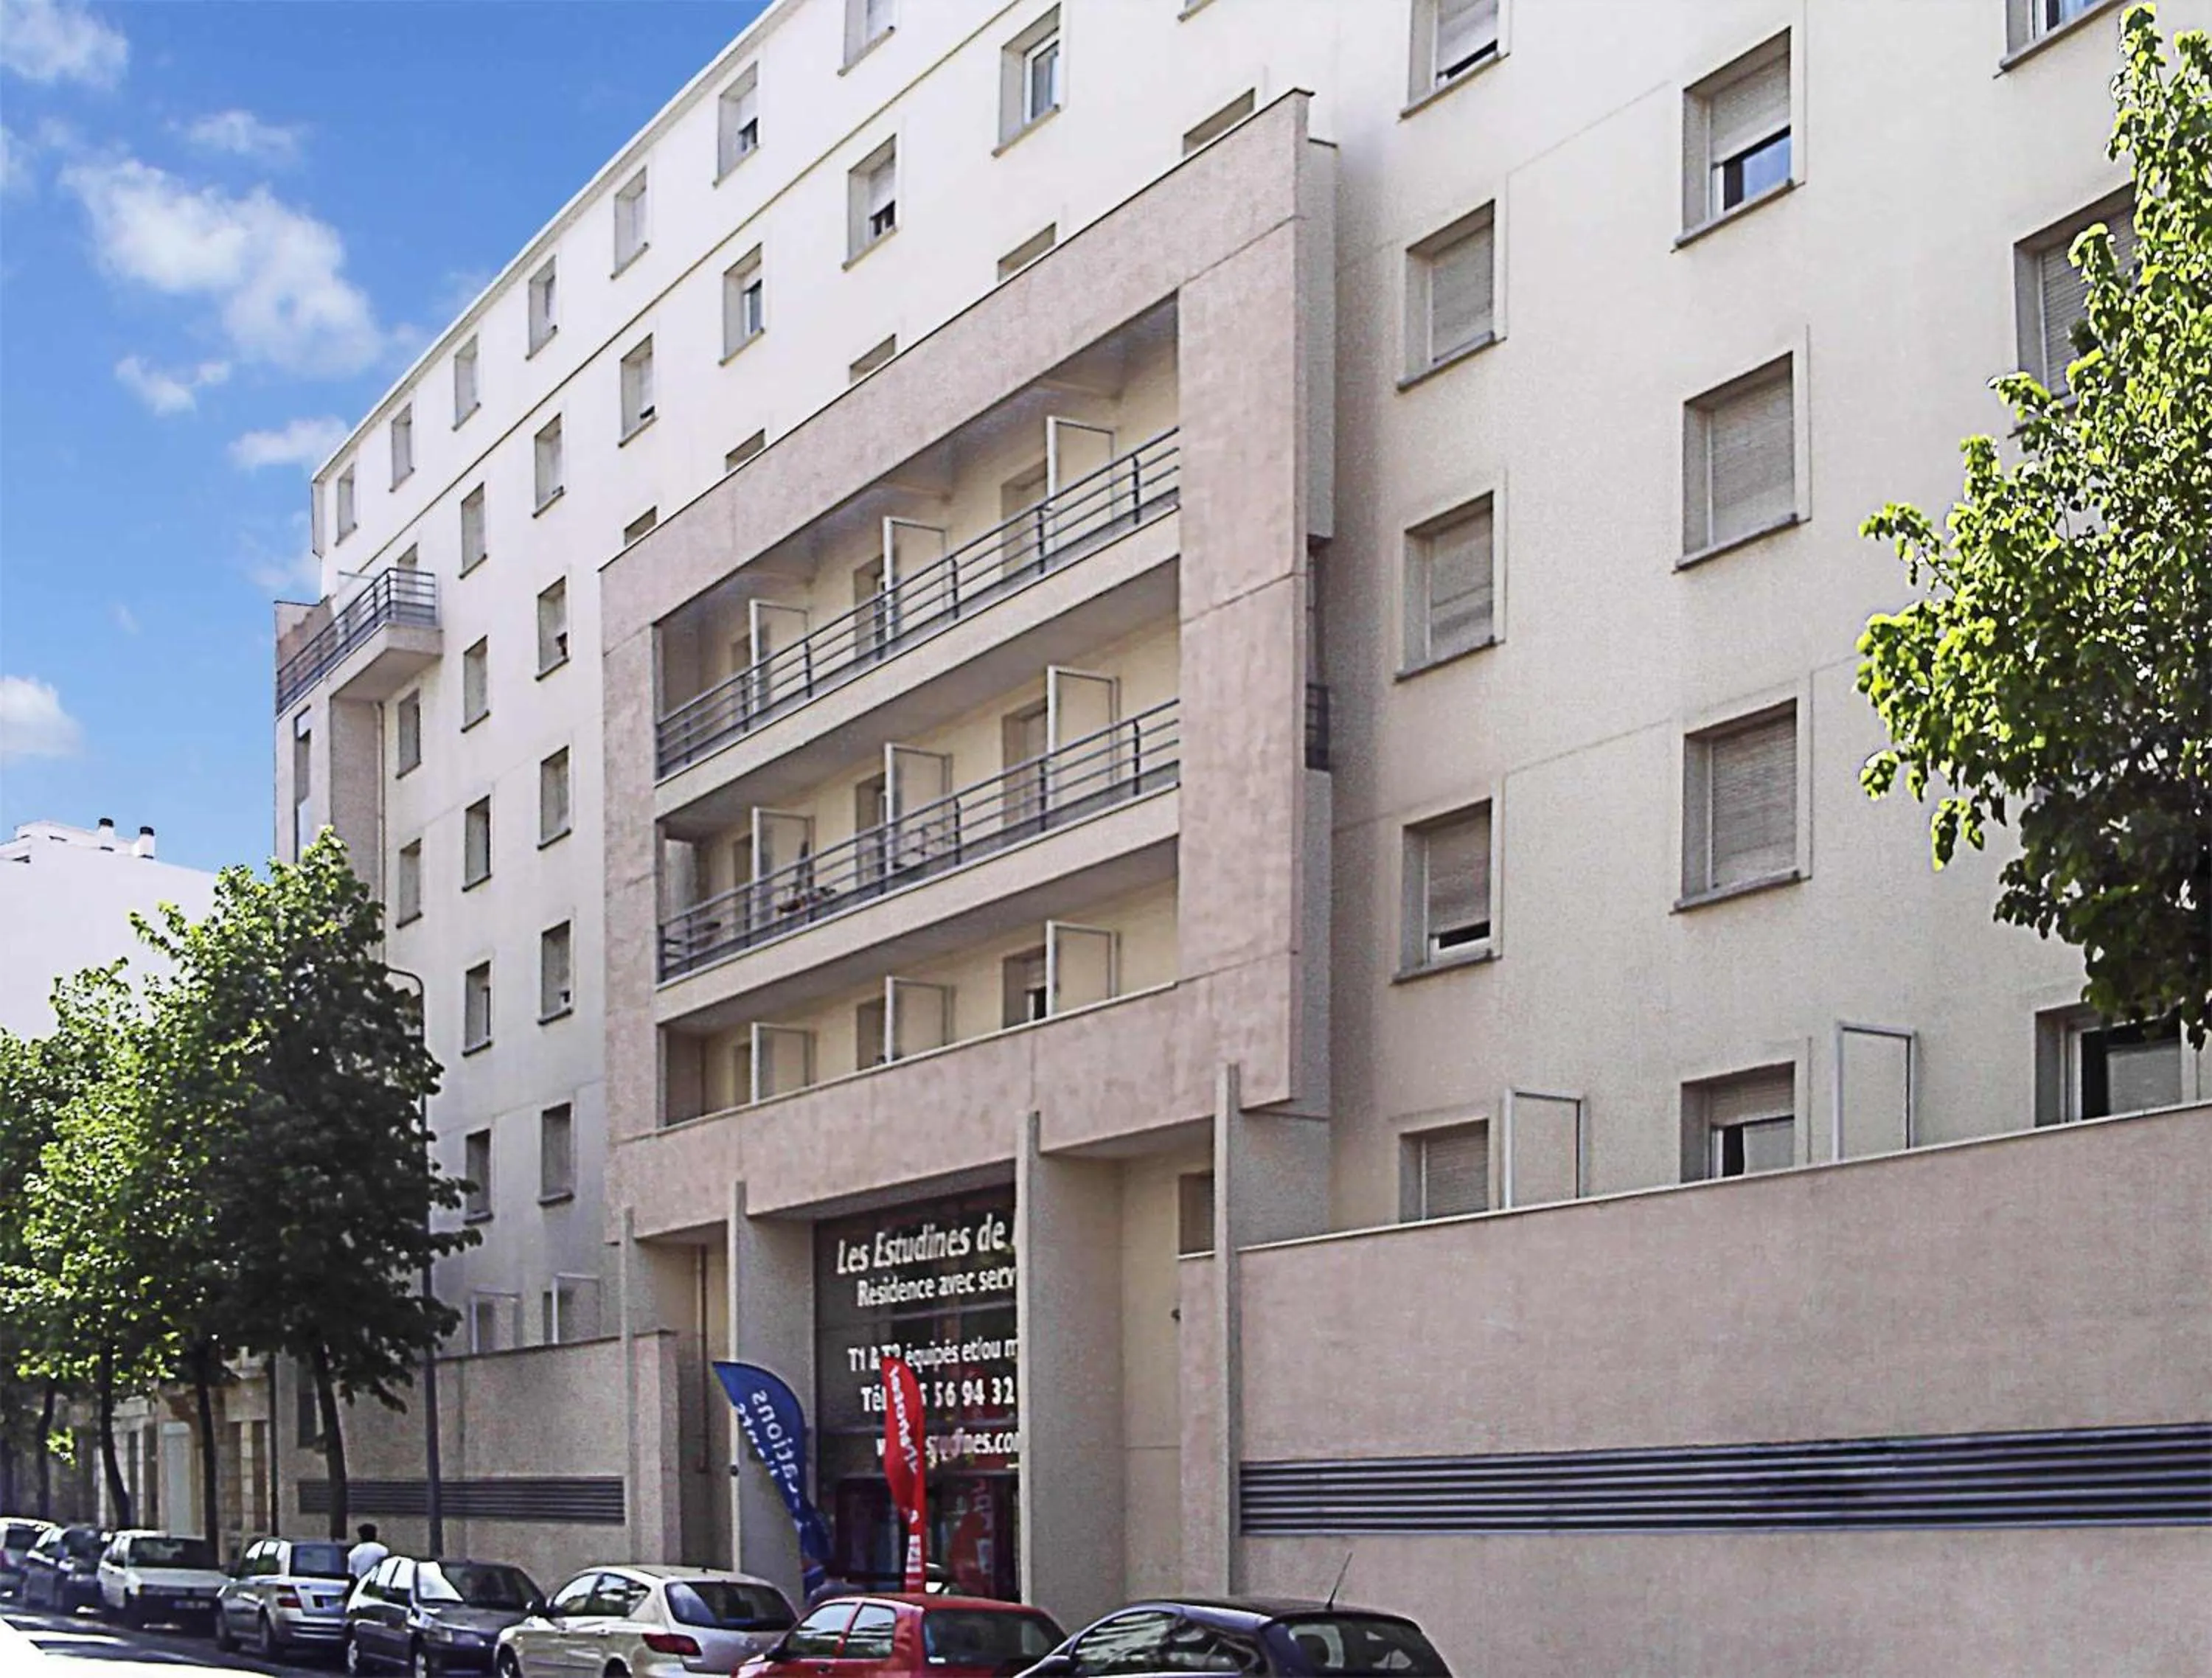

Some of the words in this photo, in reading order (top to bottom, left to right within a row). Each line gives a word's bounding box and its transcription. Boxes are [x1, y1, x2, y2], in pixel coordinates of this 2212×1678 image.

[837, 1239, 869, 1274] Les
[873, 1223, 971, 1267] Estudines
[976, 1214, 1006, 1251] de
[938, 1271, 975, 1295] avec
[934, 1379, 957, 1409] 56
[961, 1377, 987, 1407] 94
[992, 1376, 1015, 1404] 32
